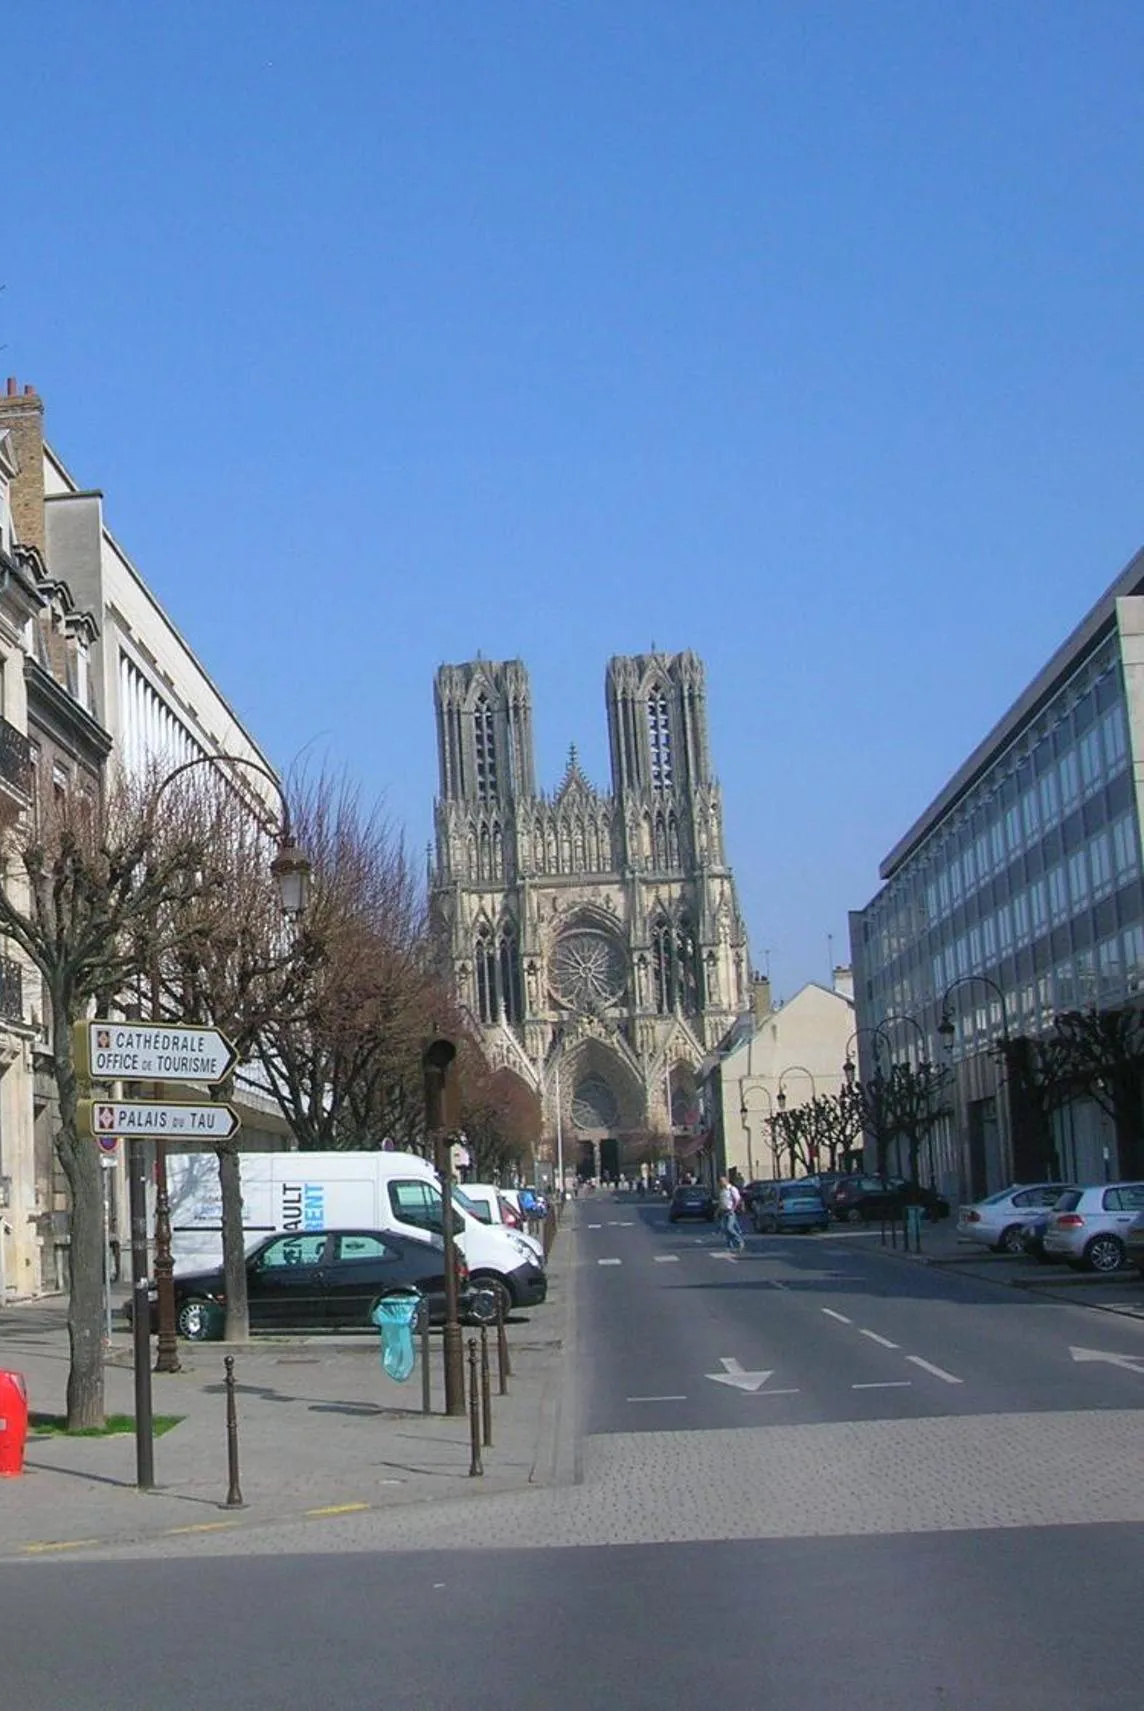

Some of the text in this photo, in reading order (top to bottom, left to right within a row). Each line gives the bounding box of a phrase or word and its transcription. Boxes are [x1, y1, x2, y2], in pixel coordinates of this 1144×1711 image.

[116, 1031, 205, 1053] CATHÉDRALE
[97, 1053, 138, 1070] OFFICE
[157, 1055, 217, 1073] TOURISME
[118, 1110, 167, 1128] PALAIS
[190, 1113, 215, 1129] TAU
